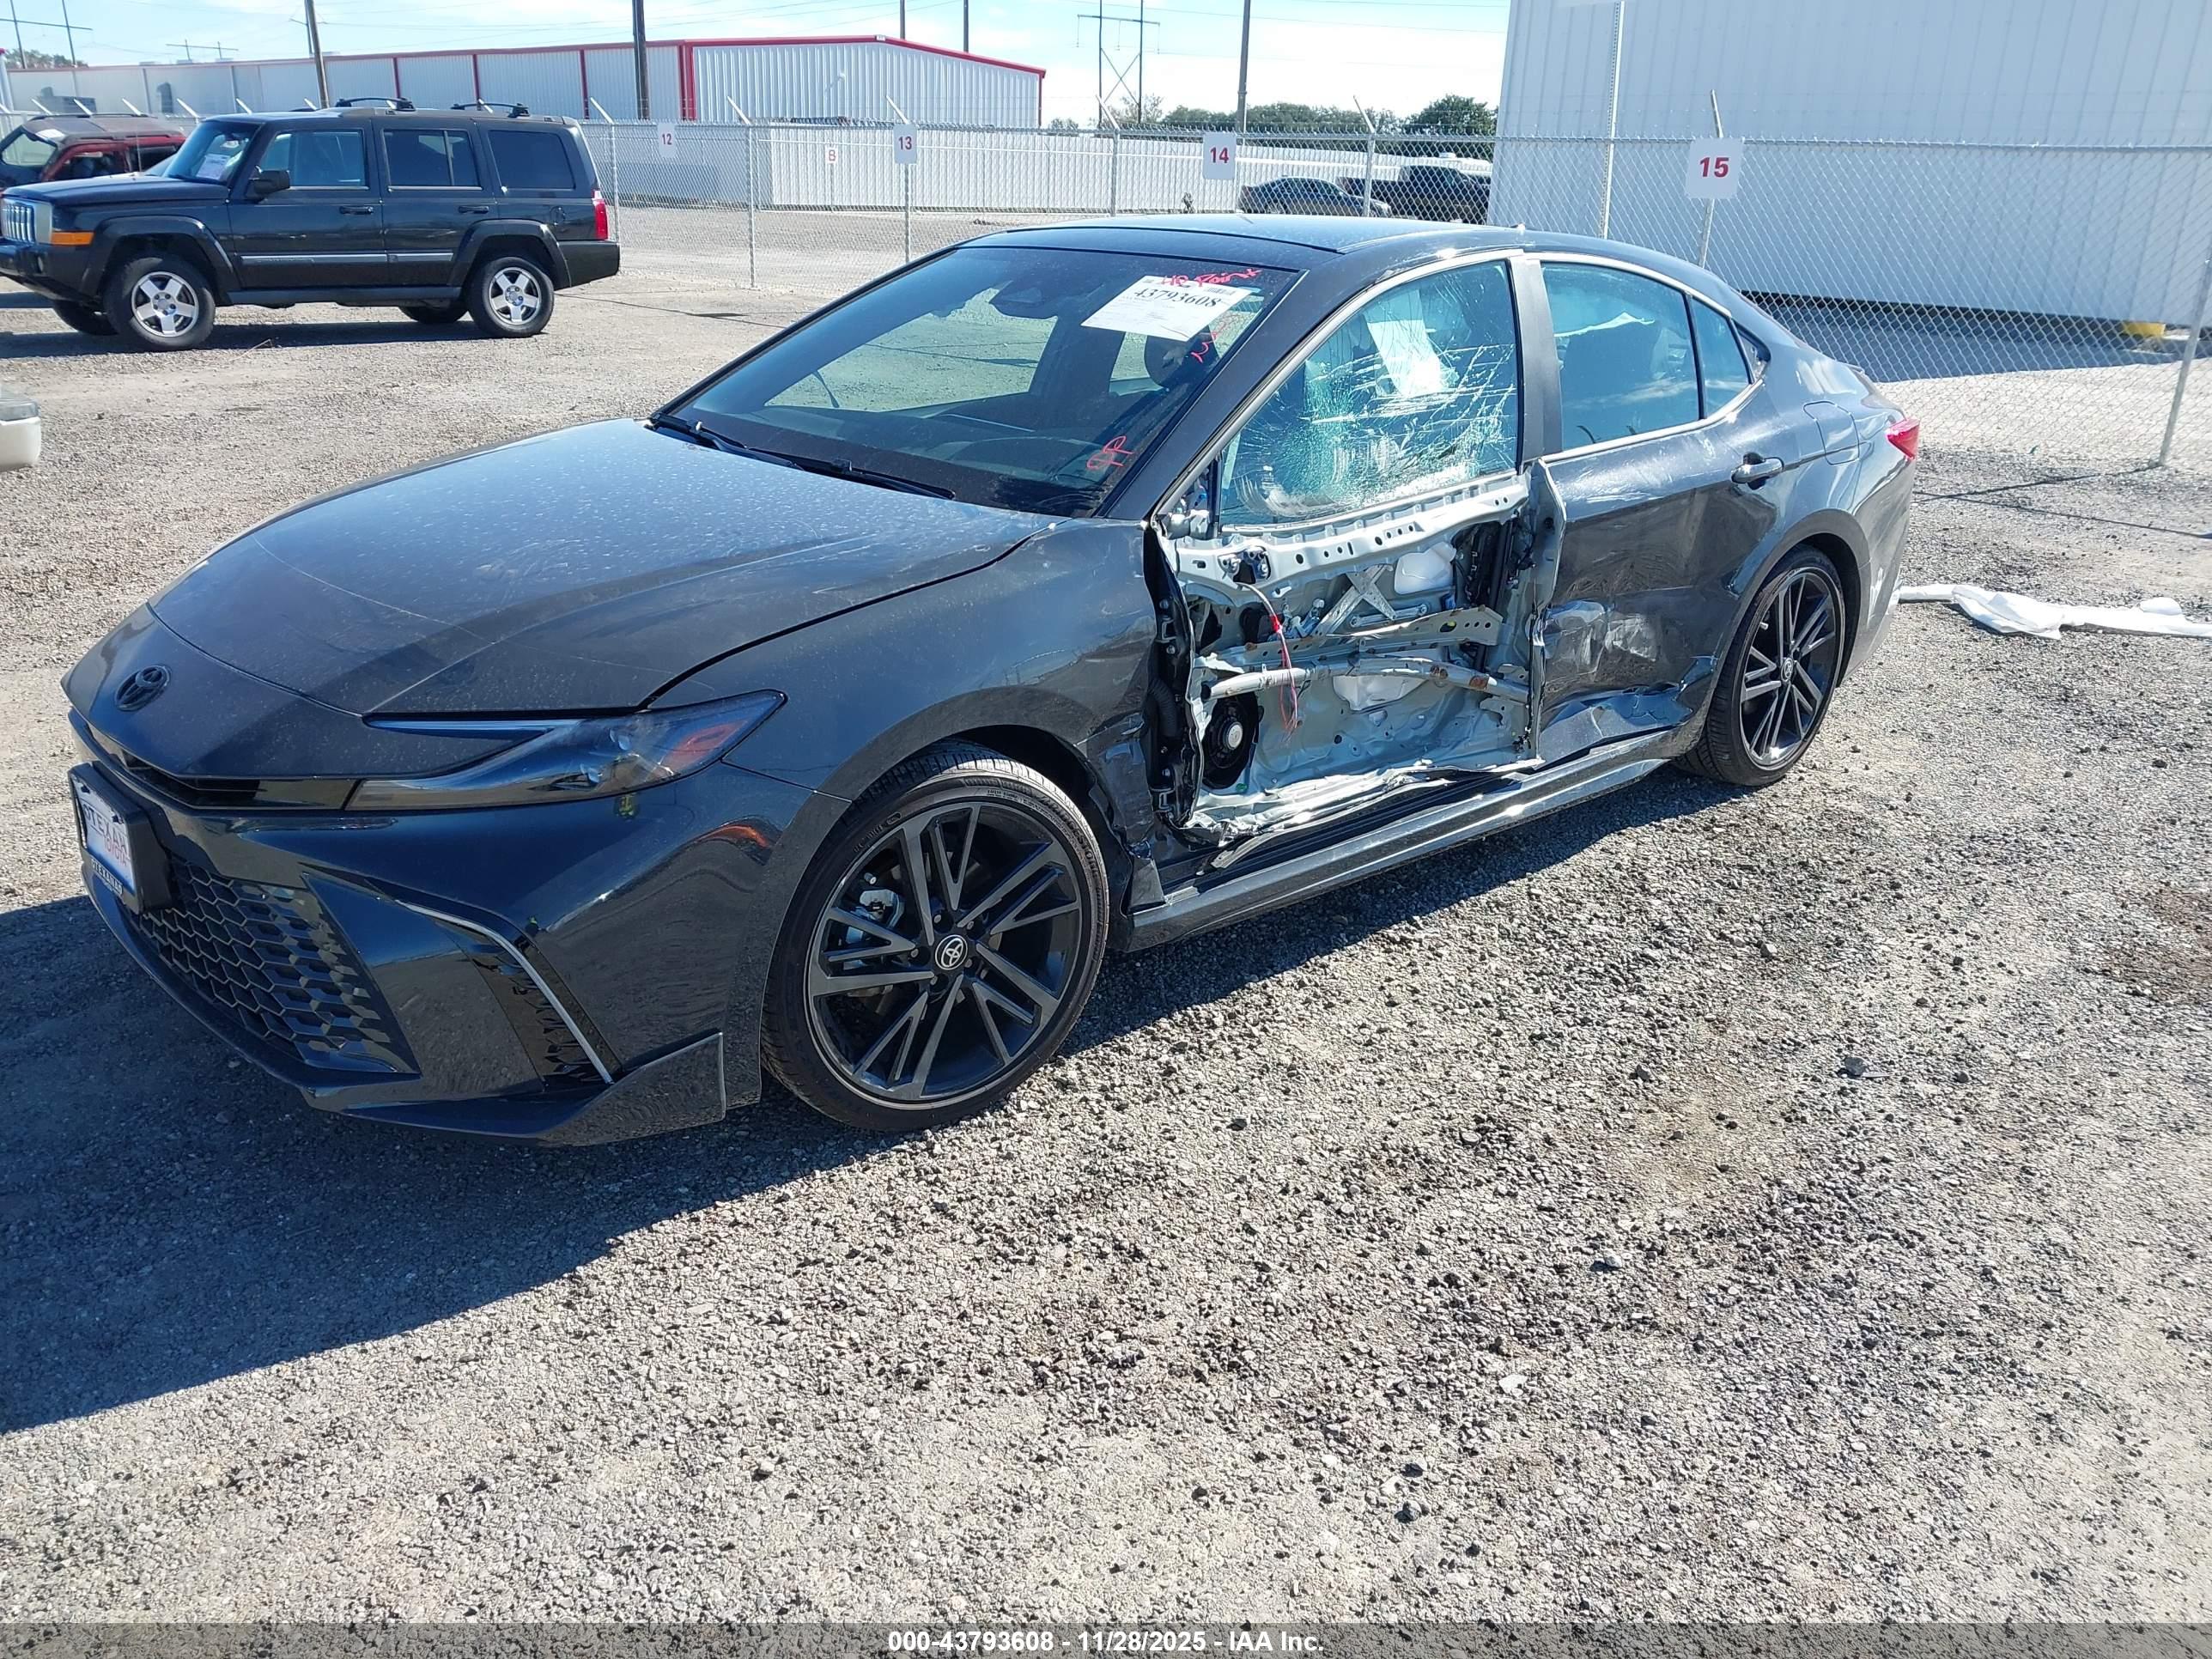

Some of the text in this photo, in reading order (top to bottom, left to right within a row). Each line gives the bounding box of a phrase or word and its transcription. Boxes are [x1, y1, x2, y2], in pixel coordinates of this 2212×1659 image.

[661, 132, 672, 145] 12
[898, 136, 913, 150] 13
[1210, 146, 1230, 164] 14
[1699, 156, 1729, 178] 15
[1133, 287, 1222, 307] 43793608
